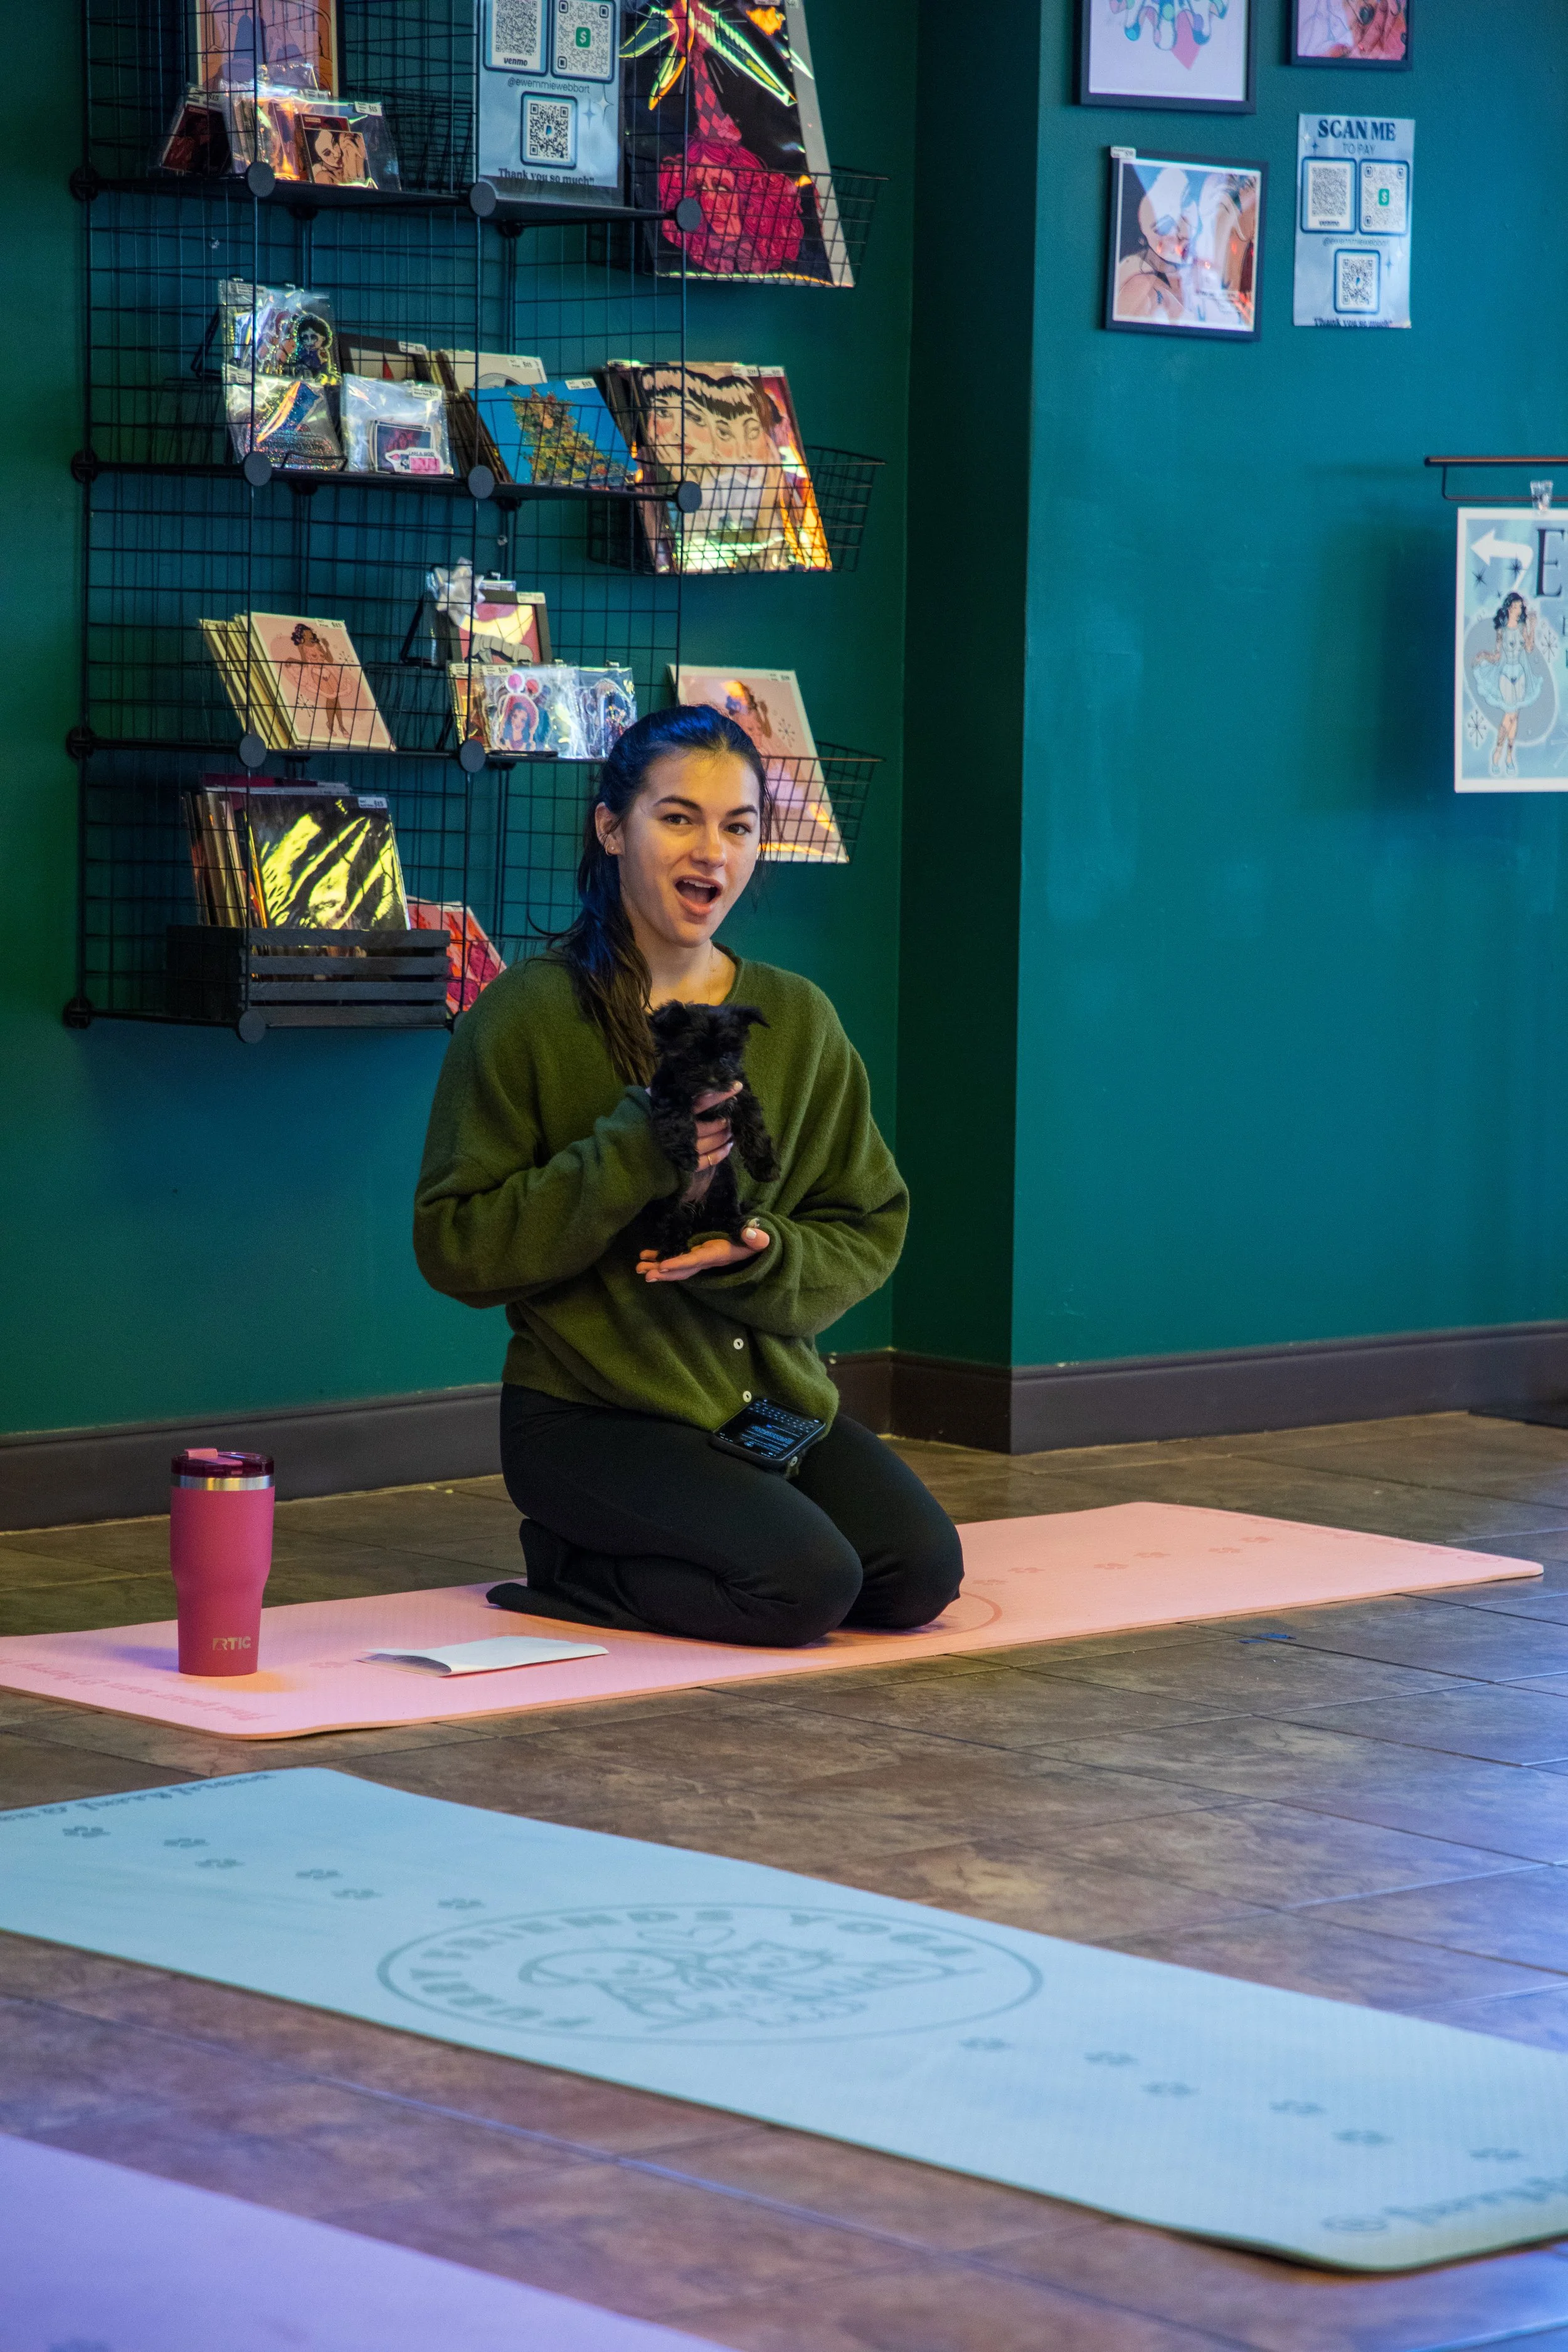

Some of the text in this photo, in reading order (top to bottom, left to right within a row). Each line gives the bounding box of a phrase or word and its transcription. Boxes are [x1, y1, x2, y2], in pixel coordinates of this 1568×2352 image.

[504, 57, 528, 66] venmo
[507, 77, 590, 93] @ewemmiewebbart
[1318, 119, 1396, 141] SCAN ME
[1343, 142, 1375, 156] TO PAY
[498, 167, 529, 179] Thank
[531, 172, 548, 182] you
[550, 174, 561, 183] so
[213, 1636, 252, 1651] RTIC
